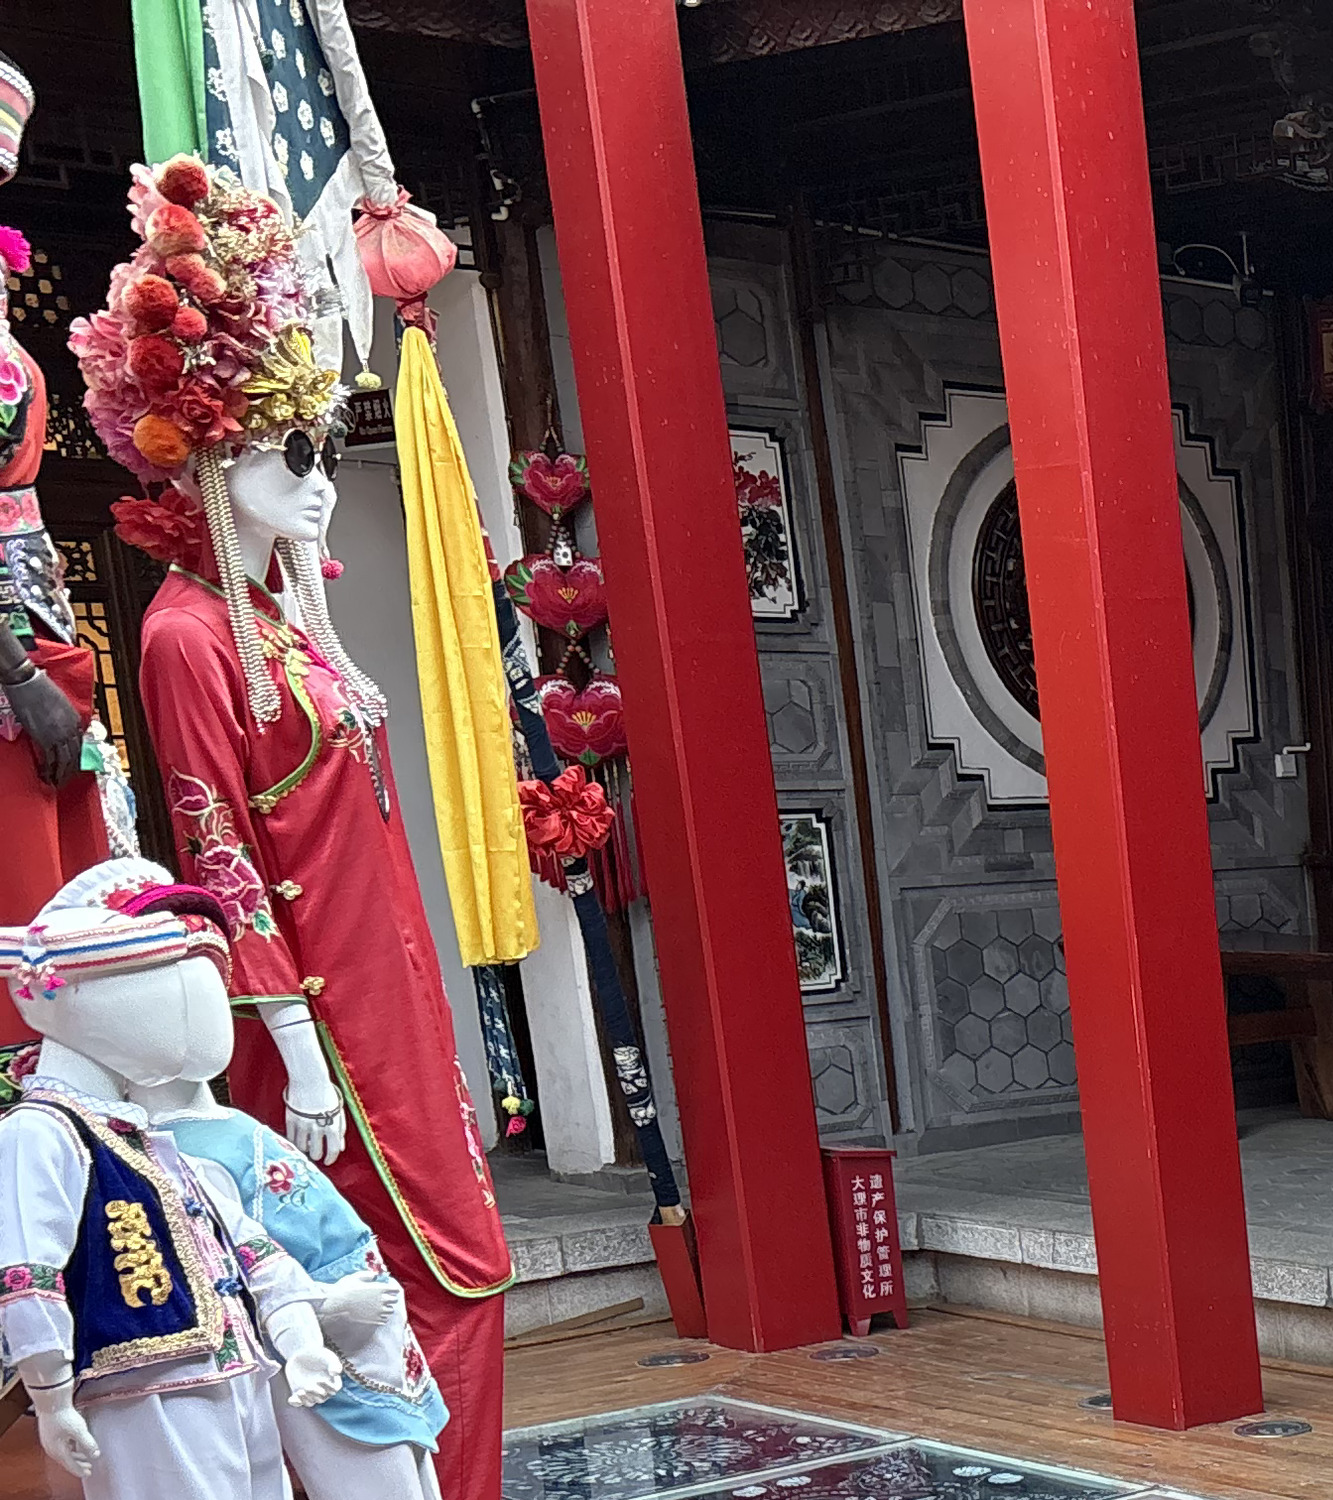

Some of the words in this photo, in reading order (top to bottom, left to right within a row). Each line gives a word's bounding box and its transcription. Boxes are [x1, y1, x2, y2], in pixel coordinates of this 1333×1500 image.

[851, 1175, 876, 1300] 大理市非物质文化
[869, 1174, 893, 1296] 遗产保护管理所
